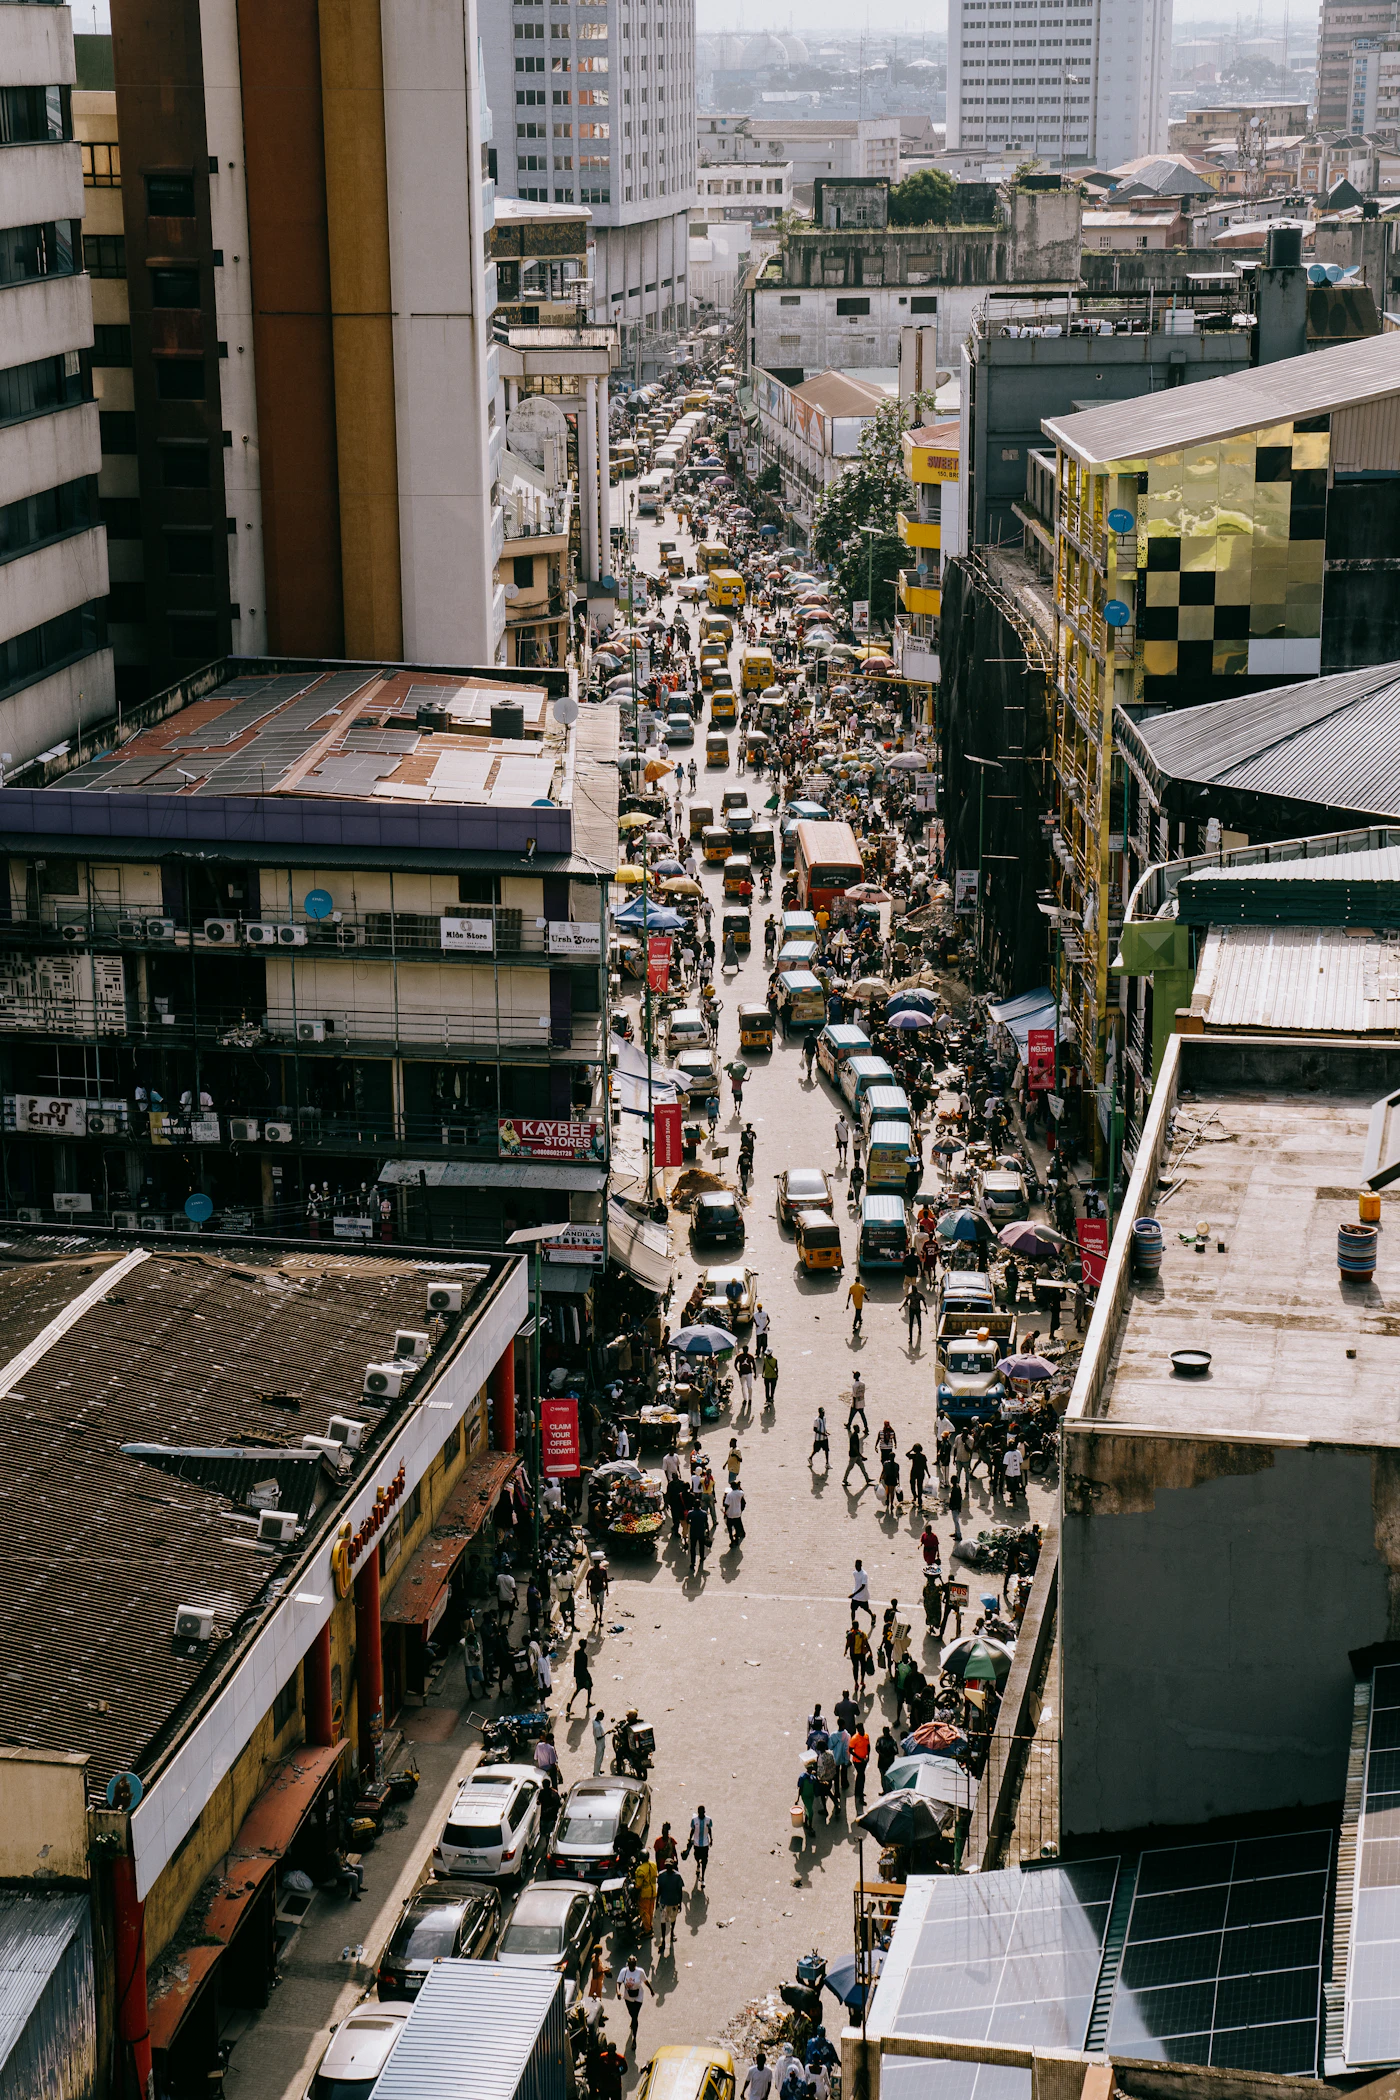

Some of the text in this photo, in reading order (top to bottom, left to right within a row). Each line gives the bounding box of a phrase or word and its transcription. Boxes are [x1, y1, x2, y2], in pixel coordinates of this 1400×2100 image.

[466, 932, 488, 940] Store
[551, 935, 600, 945] Ursh Store
[28, 1112, 66, 1127] CITY
[522, 1121, 591, 1137] KAYBEE
[544, 1136, 591, 1148] STORES
[951, 1586, 967, 1596] POS
